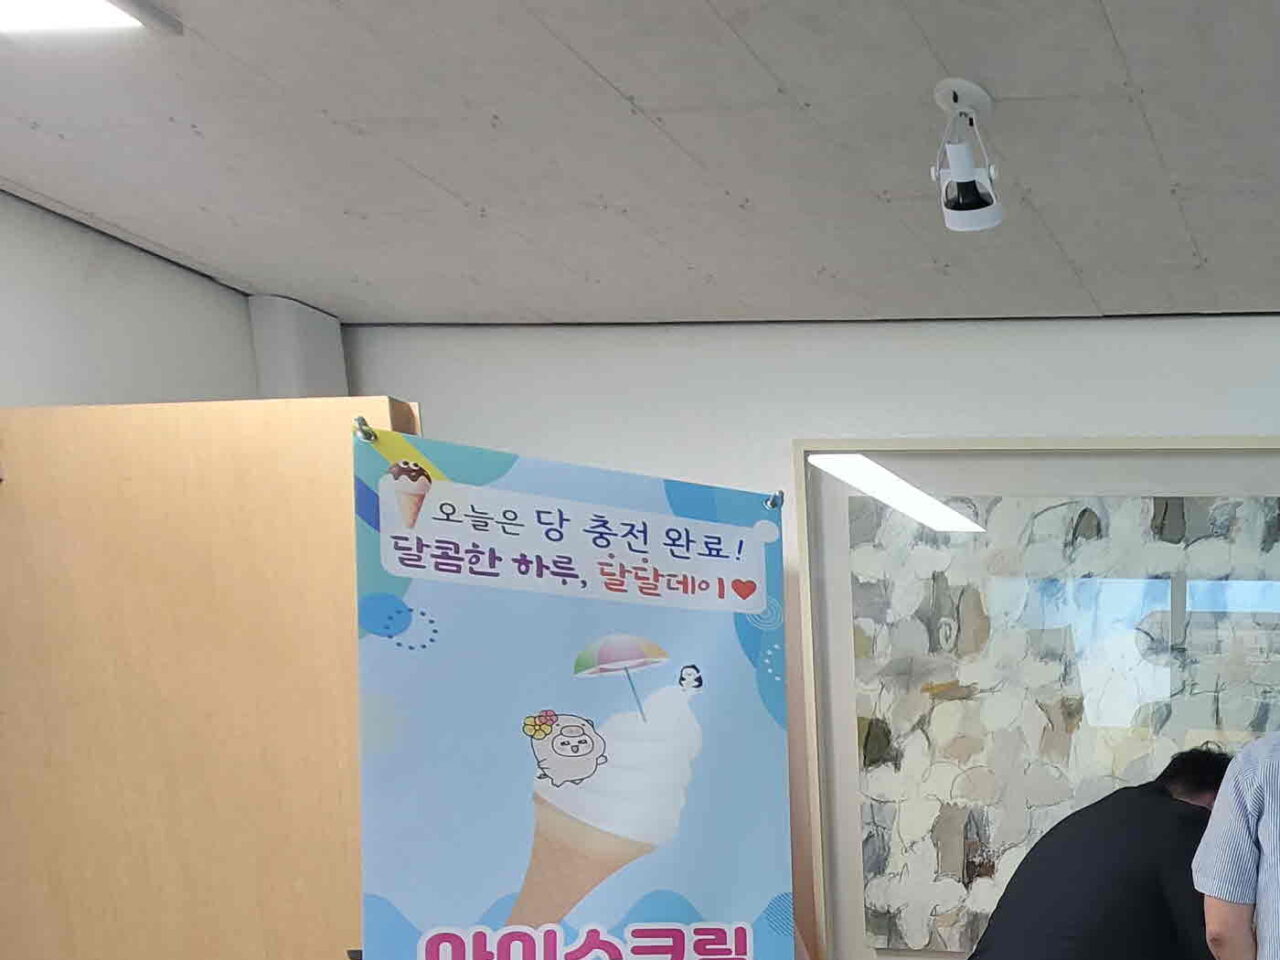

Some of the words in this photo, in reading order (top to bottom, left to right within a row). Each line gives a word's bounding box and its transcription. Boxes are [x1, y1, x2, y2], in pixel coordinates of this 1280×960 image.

[432, 502, 525, 536] 오늘은
[535, 508, 571, 542] 당
[582, 514, 649, 554] 충전
[663, 527, 744, 561] 완료!
[390, 535, 503, 577] 달콤한
[511, 553, 588, 590] 하루,
